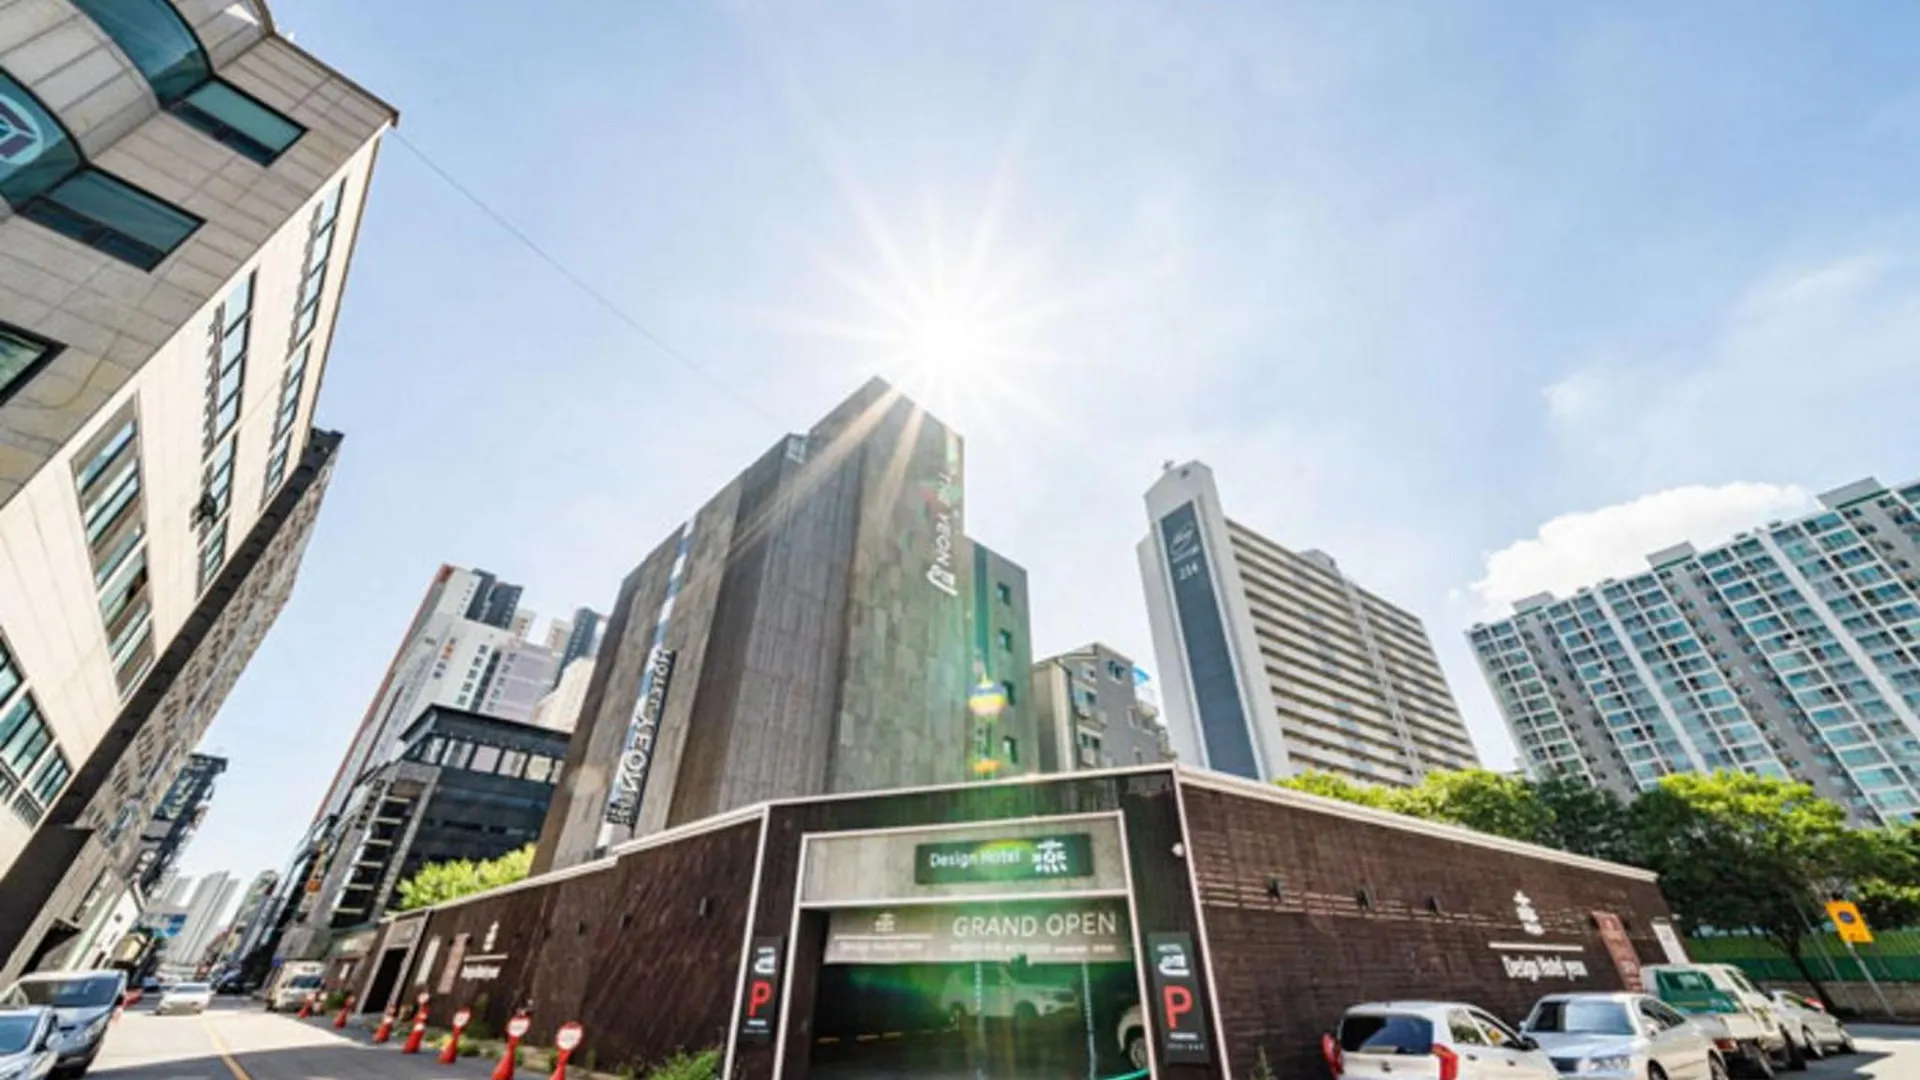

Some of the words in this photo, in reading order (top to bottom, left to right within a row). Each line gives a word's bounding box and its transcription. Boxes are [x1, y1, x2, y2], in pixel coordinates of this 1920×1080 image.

[620, 714, 656, 793] YEON
[929, 851, 977, 870] Design
[980, 849, 1021, 866] Hotel
[951, 915, 1038, 938] GRAND
[1045, 912, 1117, 936] OPEN
[746, 980, 772, 1018] P
[1163, 985, 1193, 1031] P
